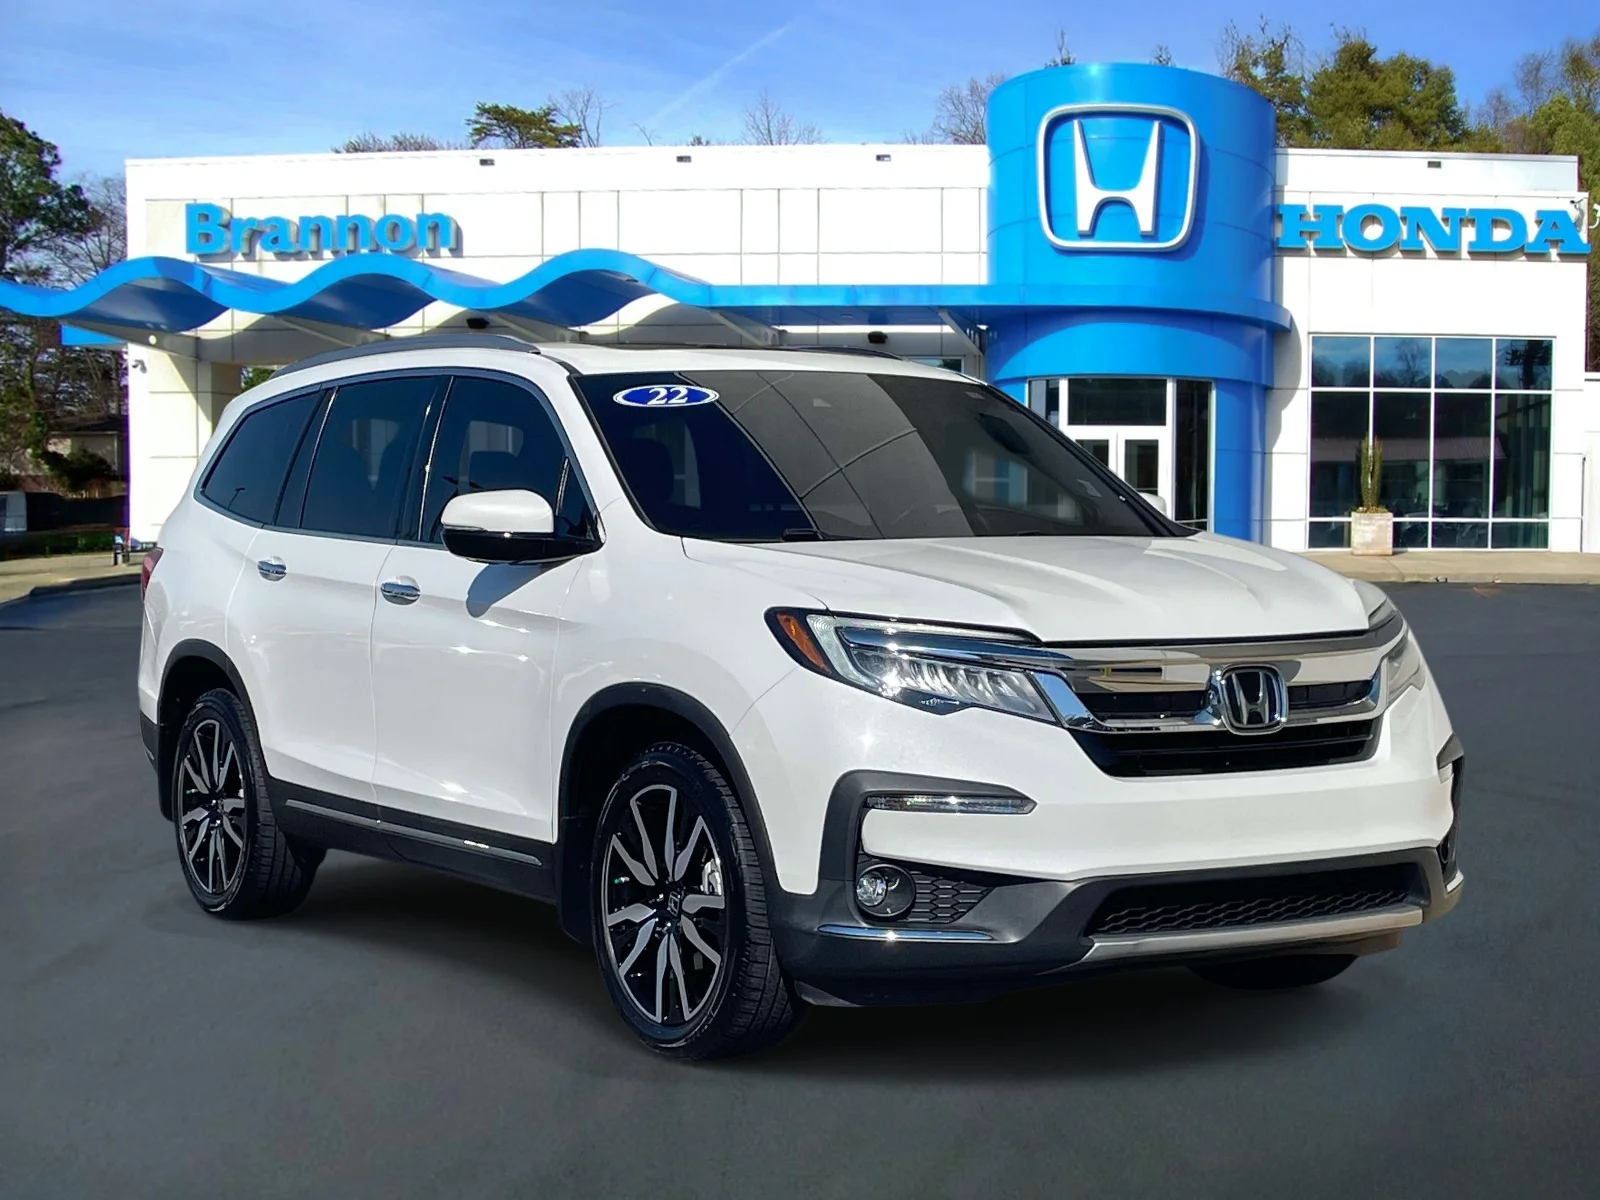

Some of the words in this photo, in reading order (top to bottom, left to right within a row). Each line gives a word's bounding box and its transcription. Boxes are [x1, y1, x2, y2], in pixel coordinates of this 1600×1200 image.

[185, 202, 461, 256] Brannon
[1276, 203, 1591, 255] HONDA
[647, 387, 689, 405] 22
